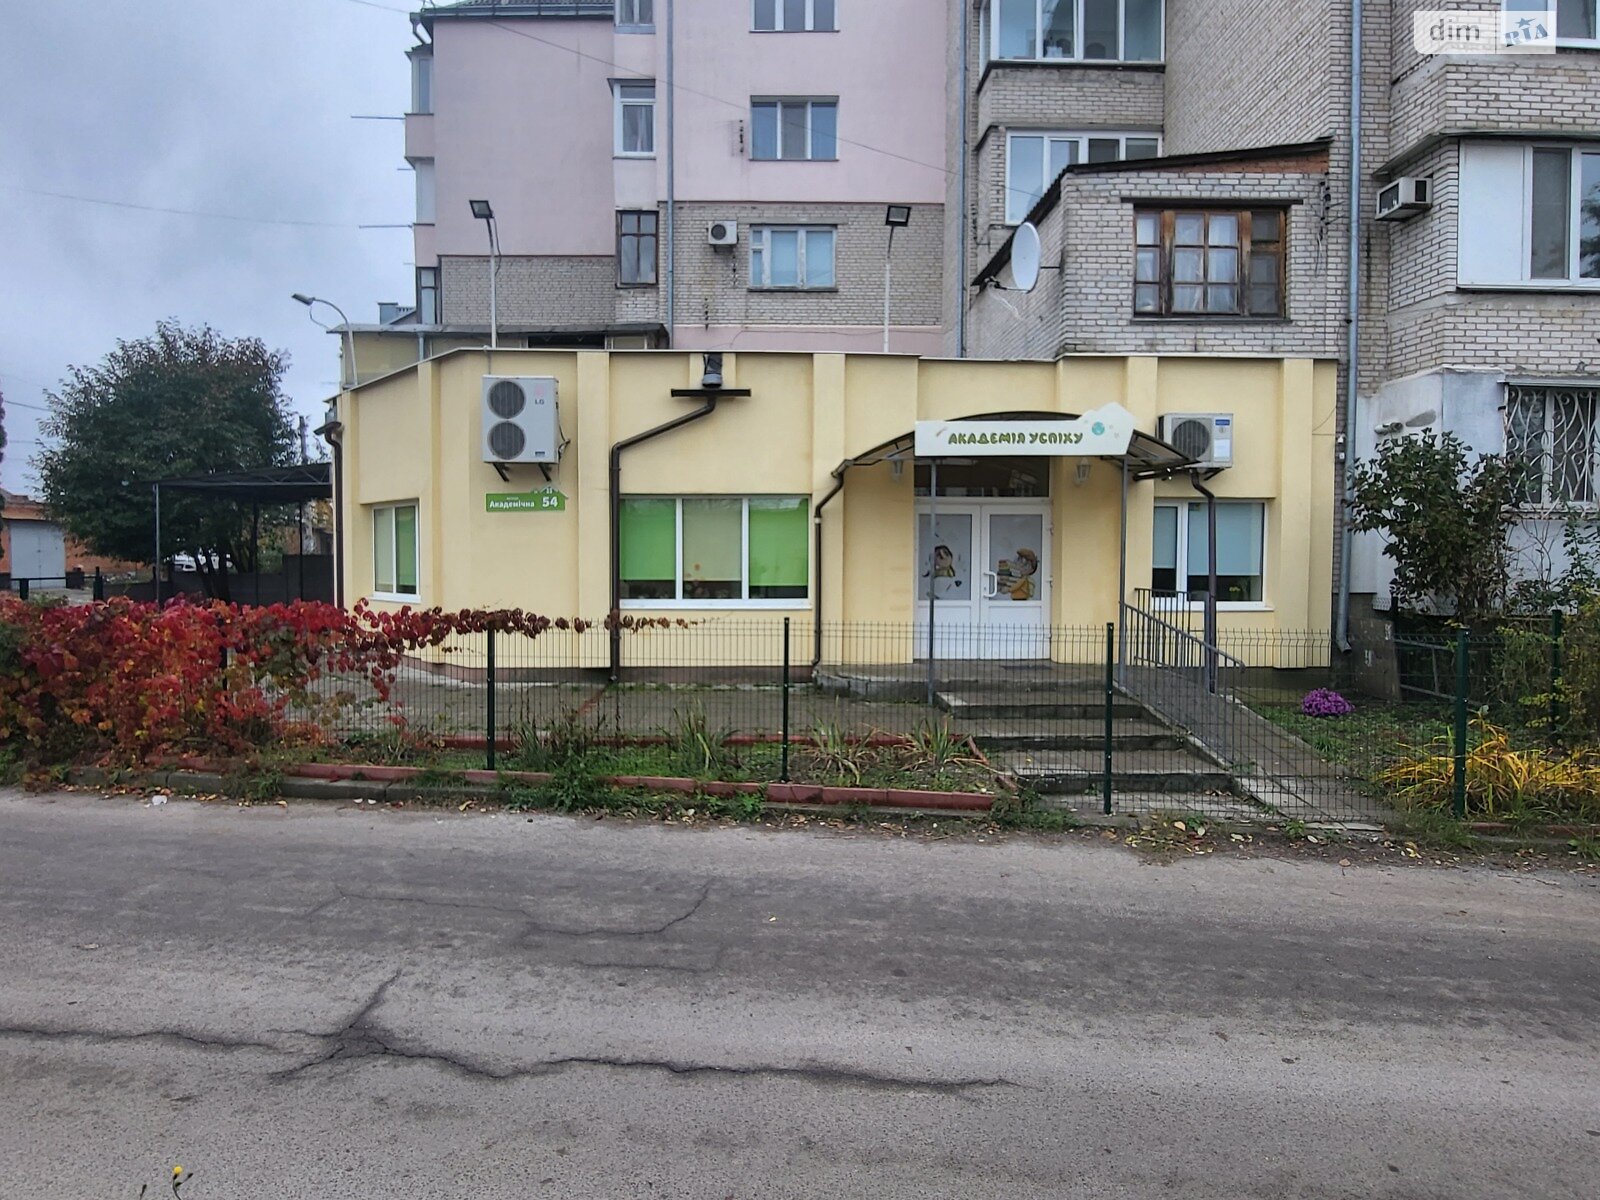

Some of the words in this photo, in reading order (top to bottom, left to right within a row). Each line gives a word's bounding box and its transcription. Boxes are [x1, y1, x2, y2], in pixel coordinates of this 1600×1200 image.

[948, 432, 1026, 445] АКАДЕМІЯ
[1029, 432, 1083, 445] УСПІХУ
[489, 500, 535, 509] Академічна
[542, 496, 558, 507] 54
